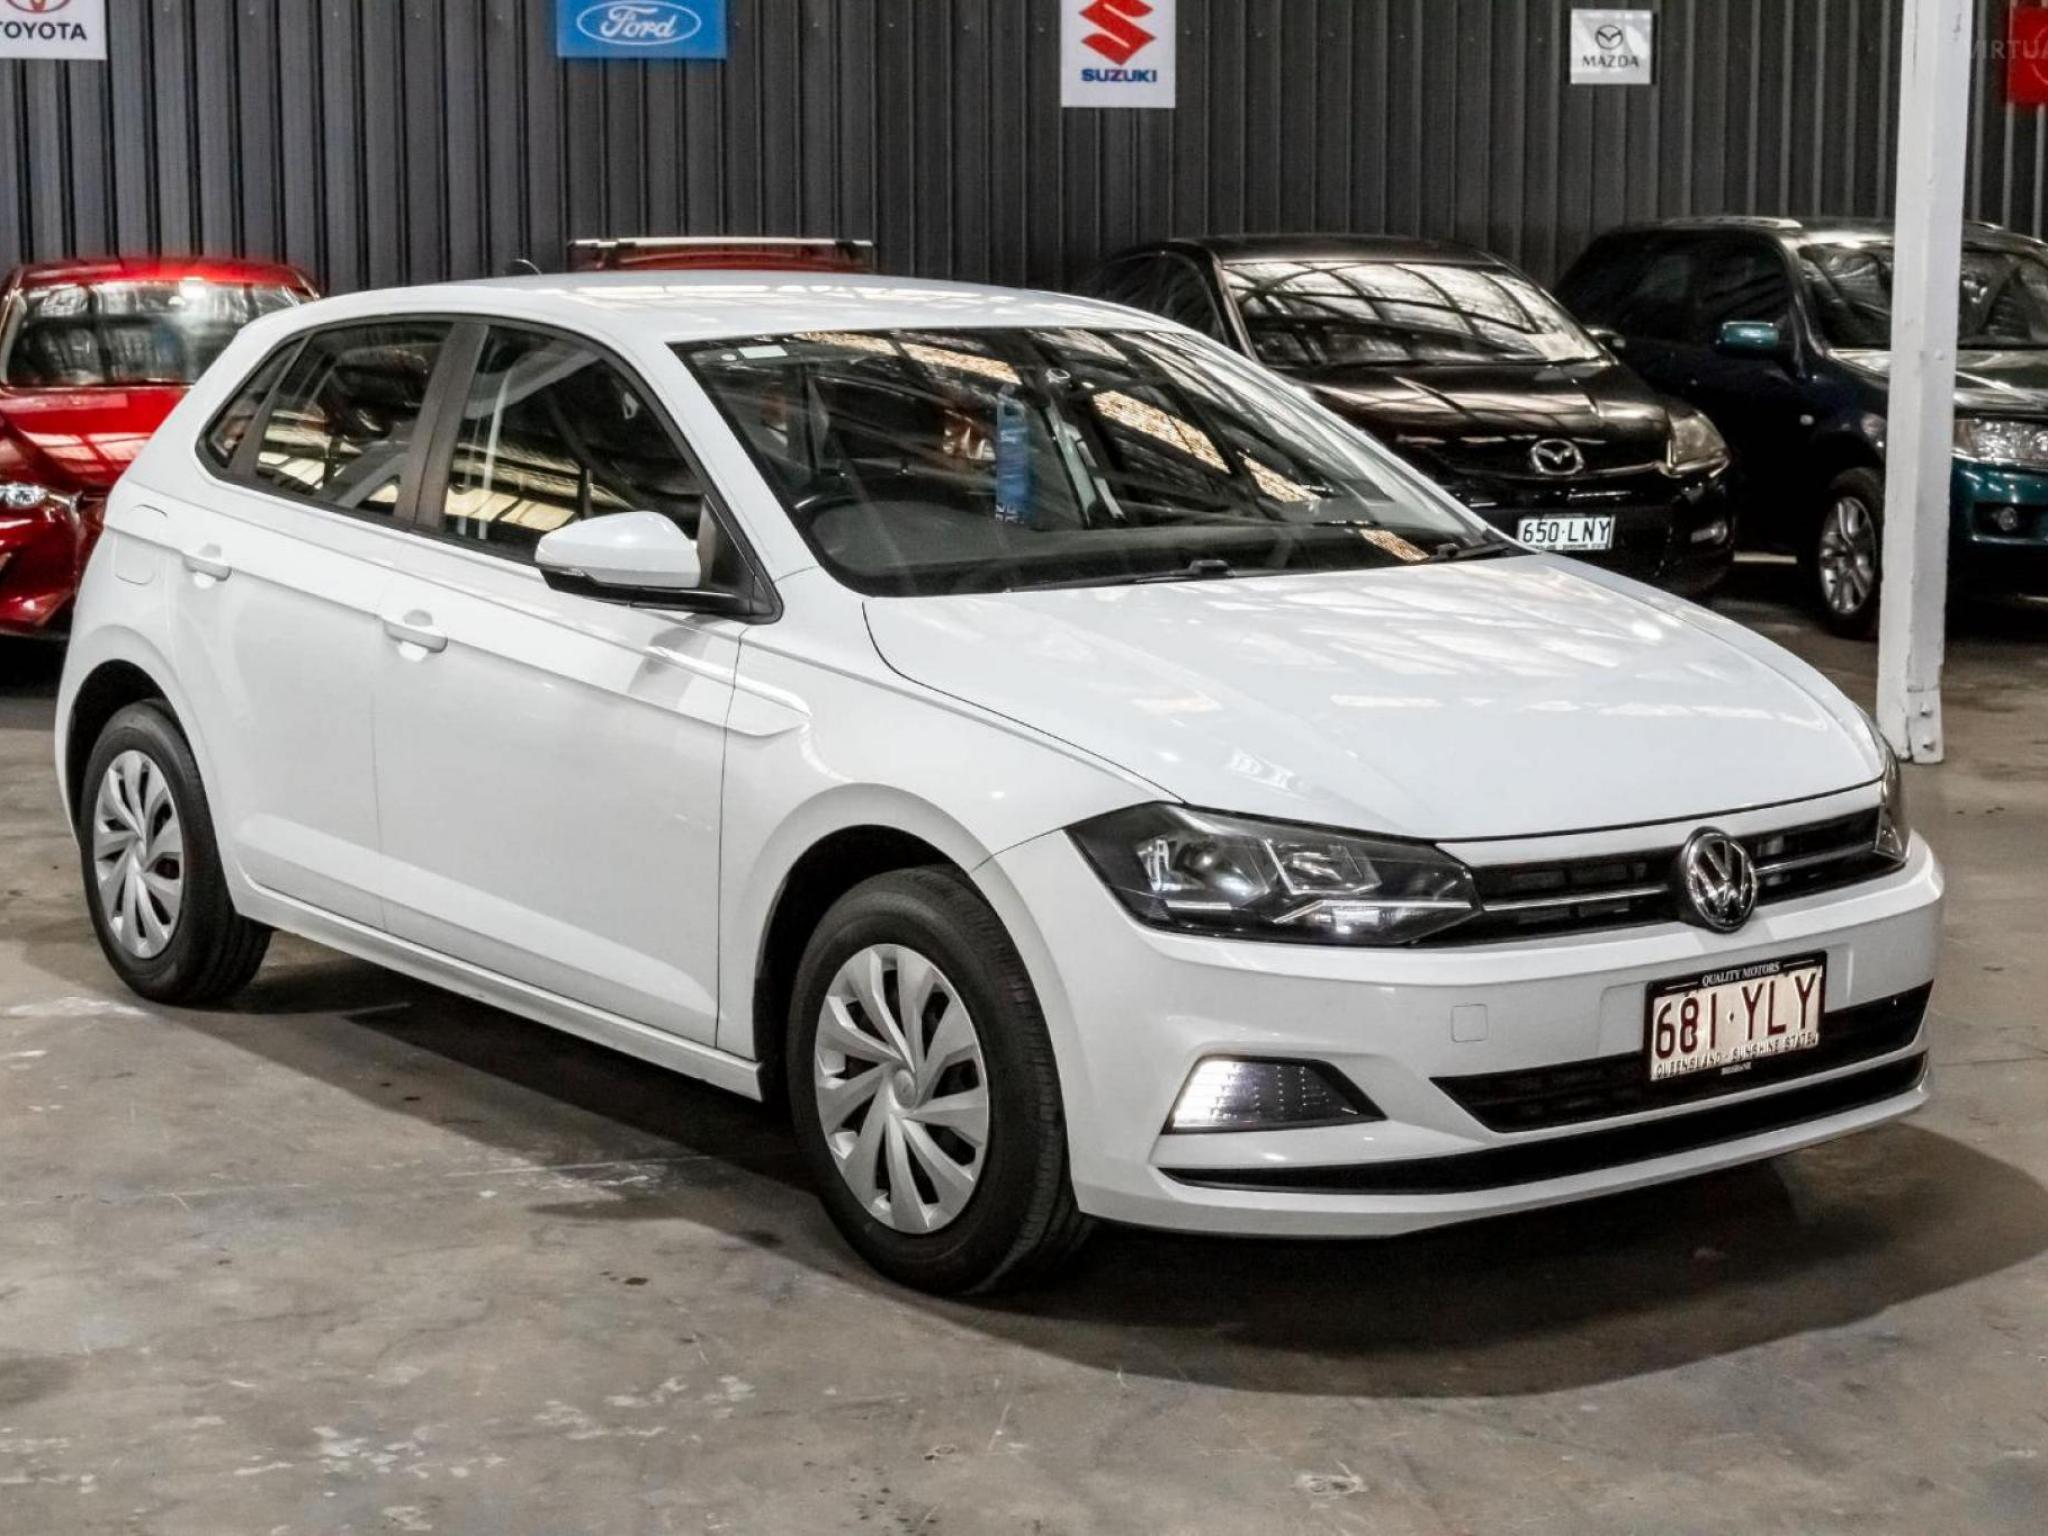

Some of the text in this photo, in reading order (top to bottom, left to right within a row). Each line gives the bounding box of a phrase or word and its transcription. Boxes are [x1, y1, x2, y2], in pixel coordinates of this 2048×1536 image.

[0, 21, 87, 40] OYOTA
[601, 5, 679, 37] Ford
[1582, 55, 1639, 68] MAZDA
[1081, 69, 1157, 82] SUZUKI
[1702, 962, 1780, 987] QUALITY MOTORS
